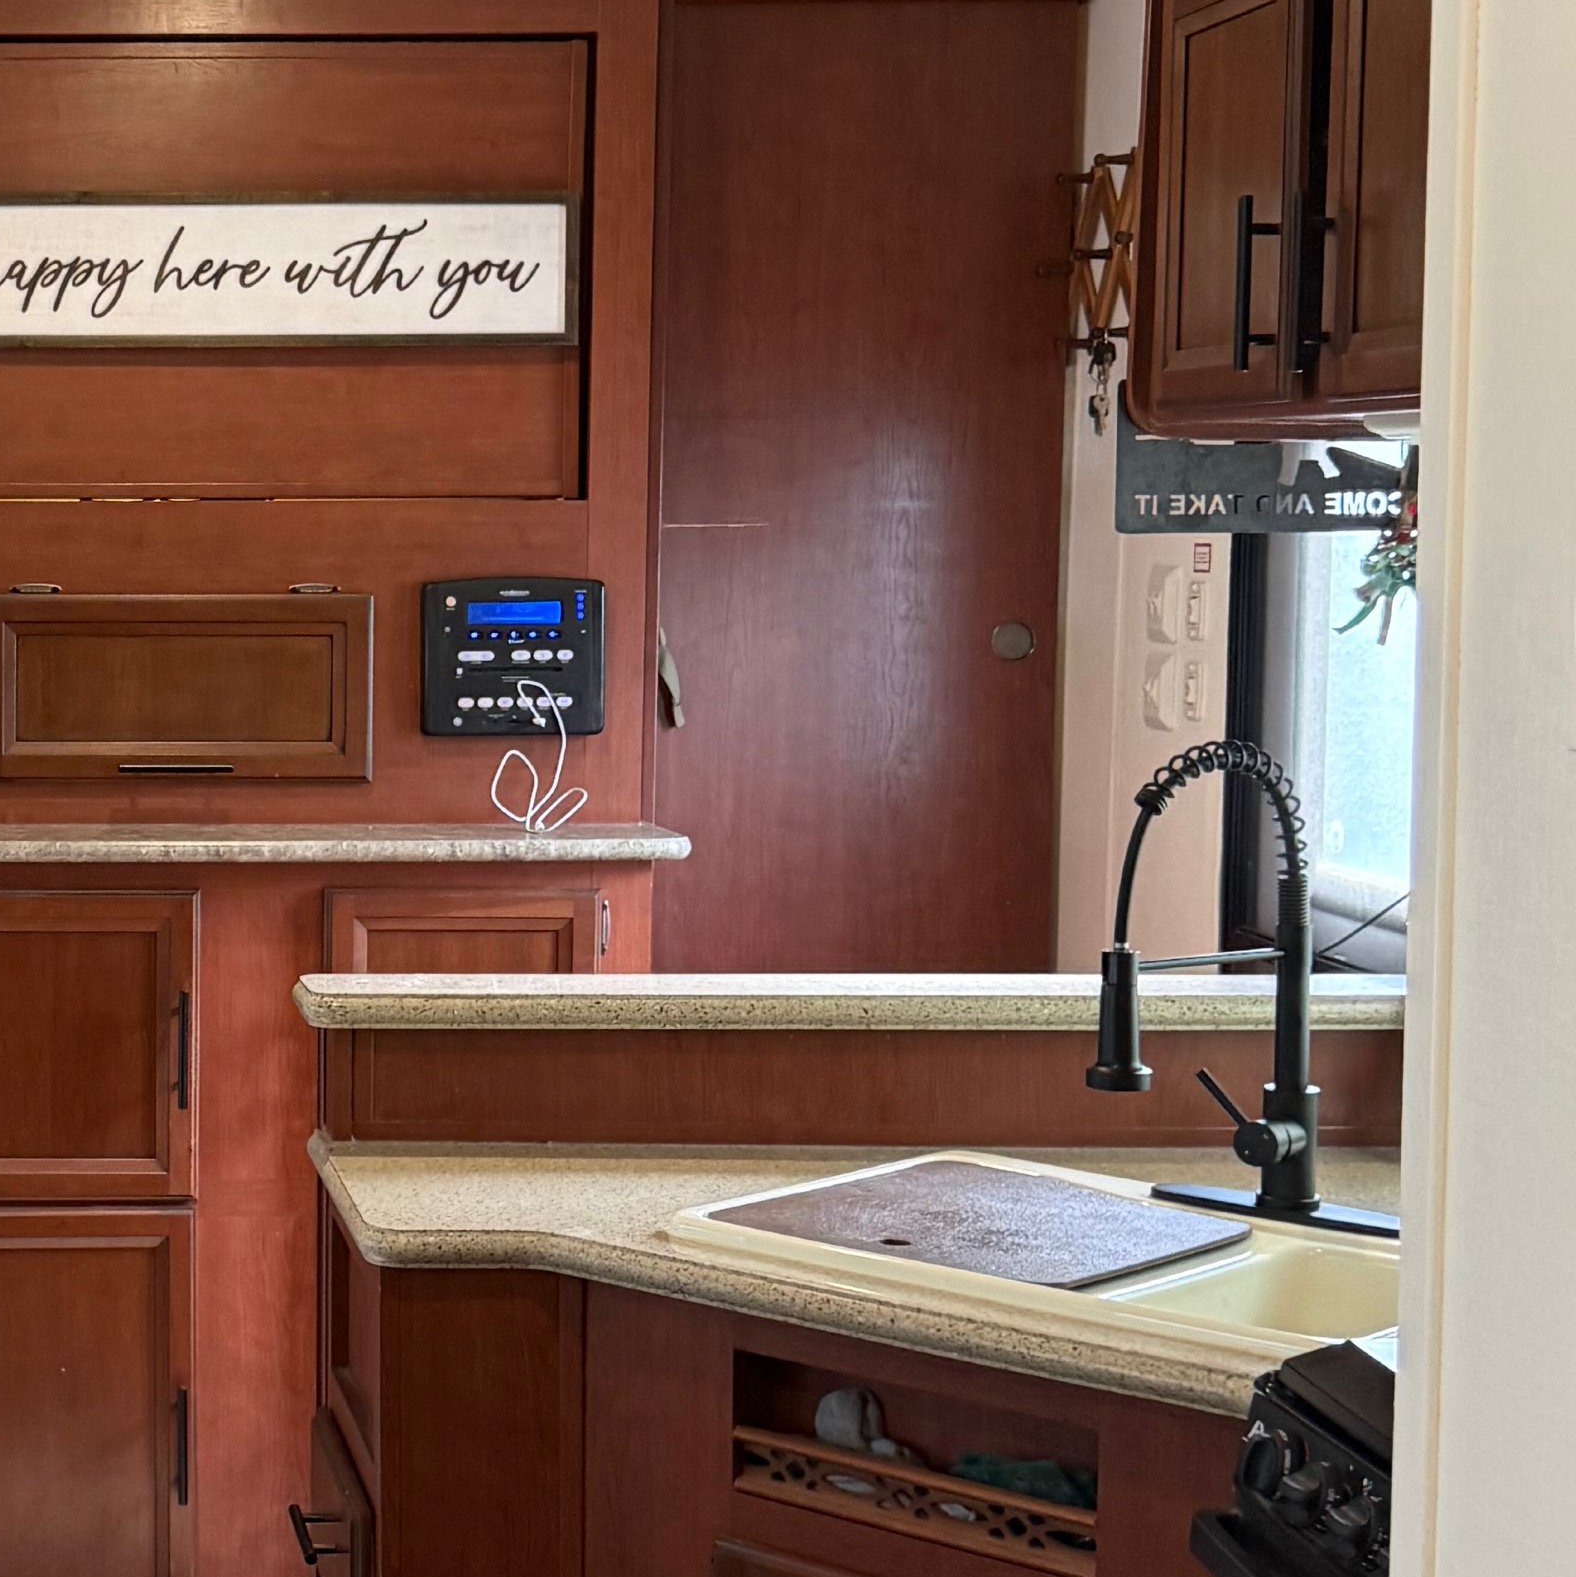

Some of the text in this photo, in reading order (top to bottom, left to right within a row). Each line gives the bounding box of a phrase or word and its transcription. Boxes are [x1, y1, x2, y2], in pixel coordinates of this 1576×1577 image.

[153, 225, 271, 293] here
[283, 218, 428, 299] with
[433, 258, 542, 320] you
